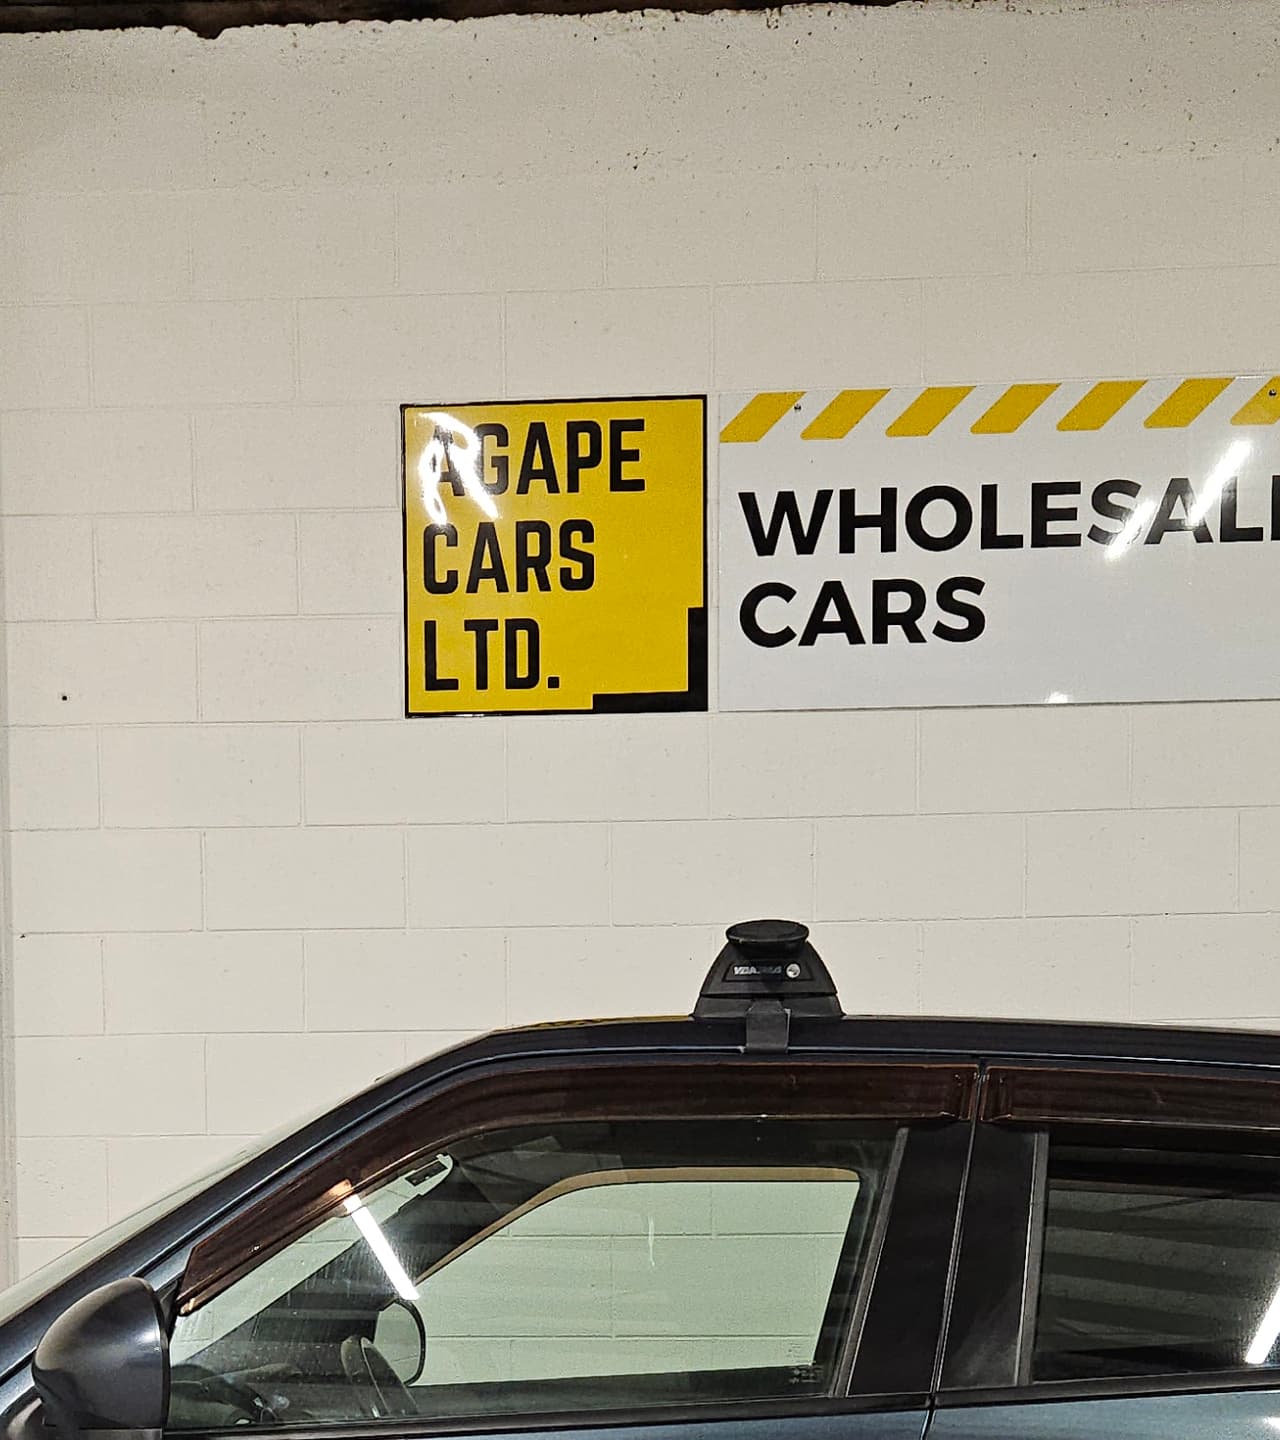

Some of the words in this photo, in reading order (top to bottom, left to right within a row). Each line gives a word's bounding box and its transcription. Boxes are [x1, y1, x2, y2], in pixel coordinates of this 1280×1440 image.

[427, 418, 646, 497] AGAPE
[423, 518, 595, 595] CARS
[739, 576, 986, 649] CARS
[424, 617, 560, 692] LTD.
